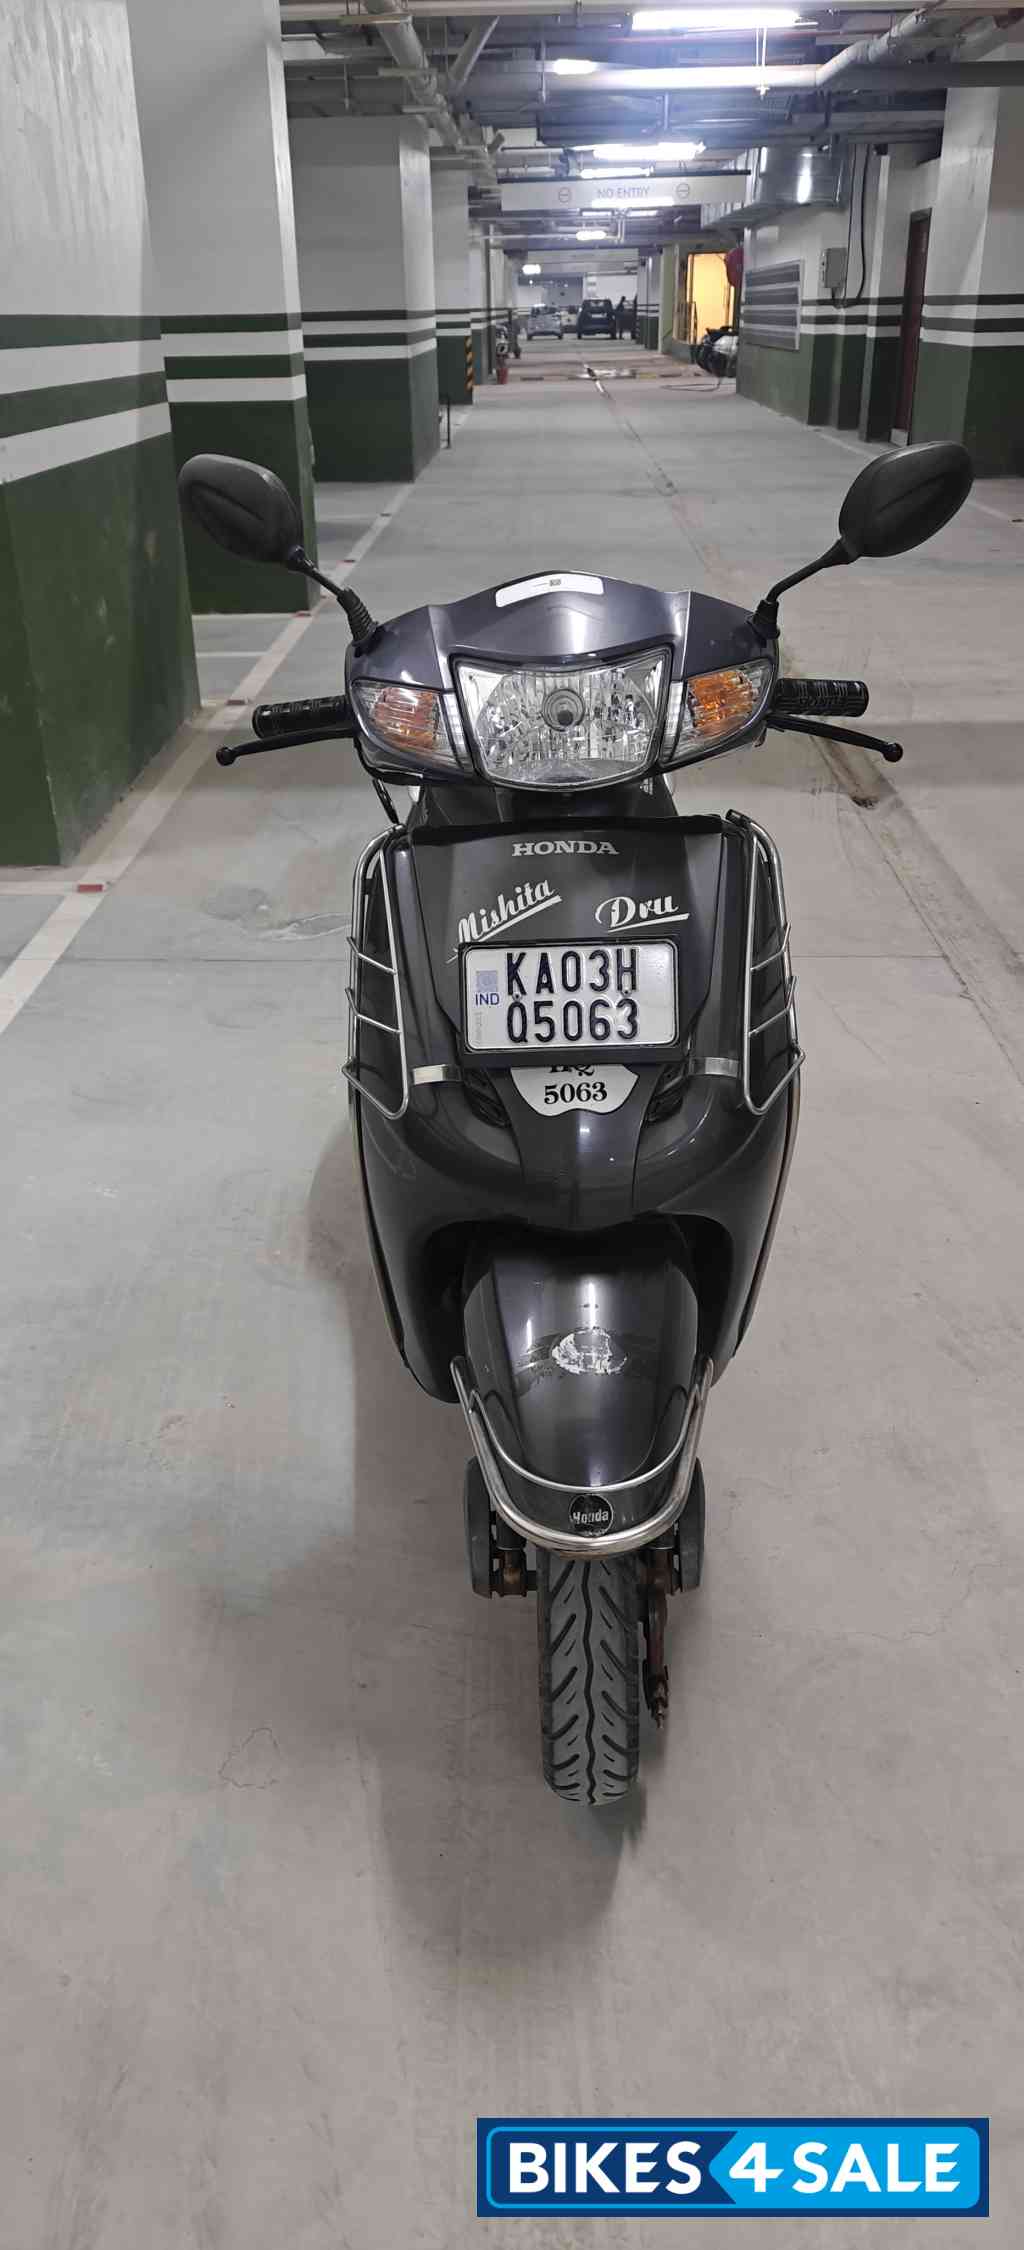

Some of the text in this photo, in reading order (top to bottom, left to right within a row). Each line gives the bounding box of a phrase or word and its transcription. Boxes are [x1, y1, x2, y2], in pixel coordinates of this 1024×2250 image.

[597, 186, 649, 199] NO ENTRY
[511, 840, 620, 857] HONDA
[457, 879, 556, 943] Mishita
[594, 895, 679, 928] Dru
[506, 948, 638, 996] KA03H
[475, 992, 500, 1006] IND
[506, 998, 638, 1043] Q5063
[543, 1081, 608, 1104] 5063
